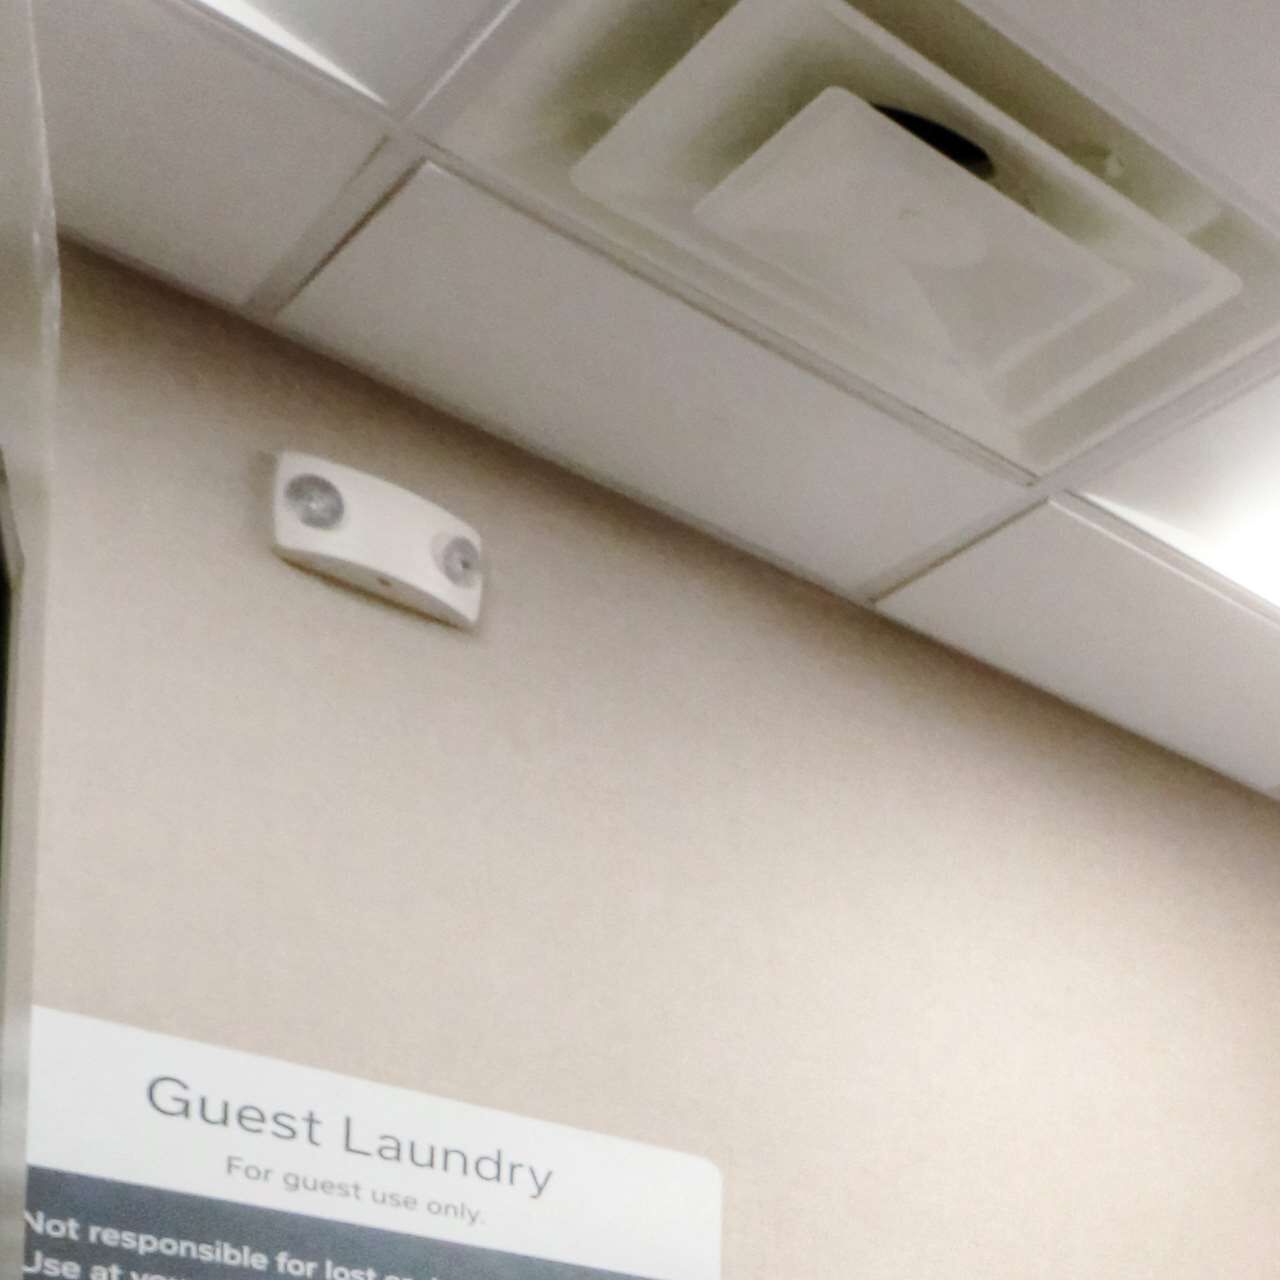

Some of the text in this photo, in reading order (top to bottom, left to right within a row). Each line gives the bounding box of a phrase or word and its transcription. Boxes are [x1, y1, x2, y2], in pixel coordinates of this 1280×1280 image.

[146, 1075, 554, 1198] Guest Laundry
[226, 1155, 485, 1226] For guest use only.
[89, 1225, 269, 1272] responsible
[276, 1251, 318, 1279] for
